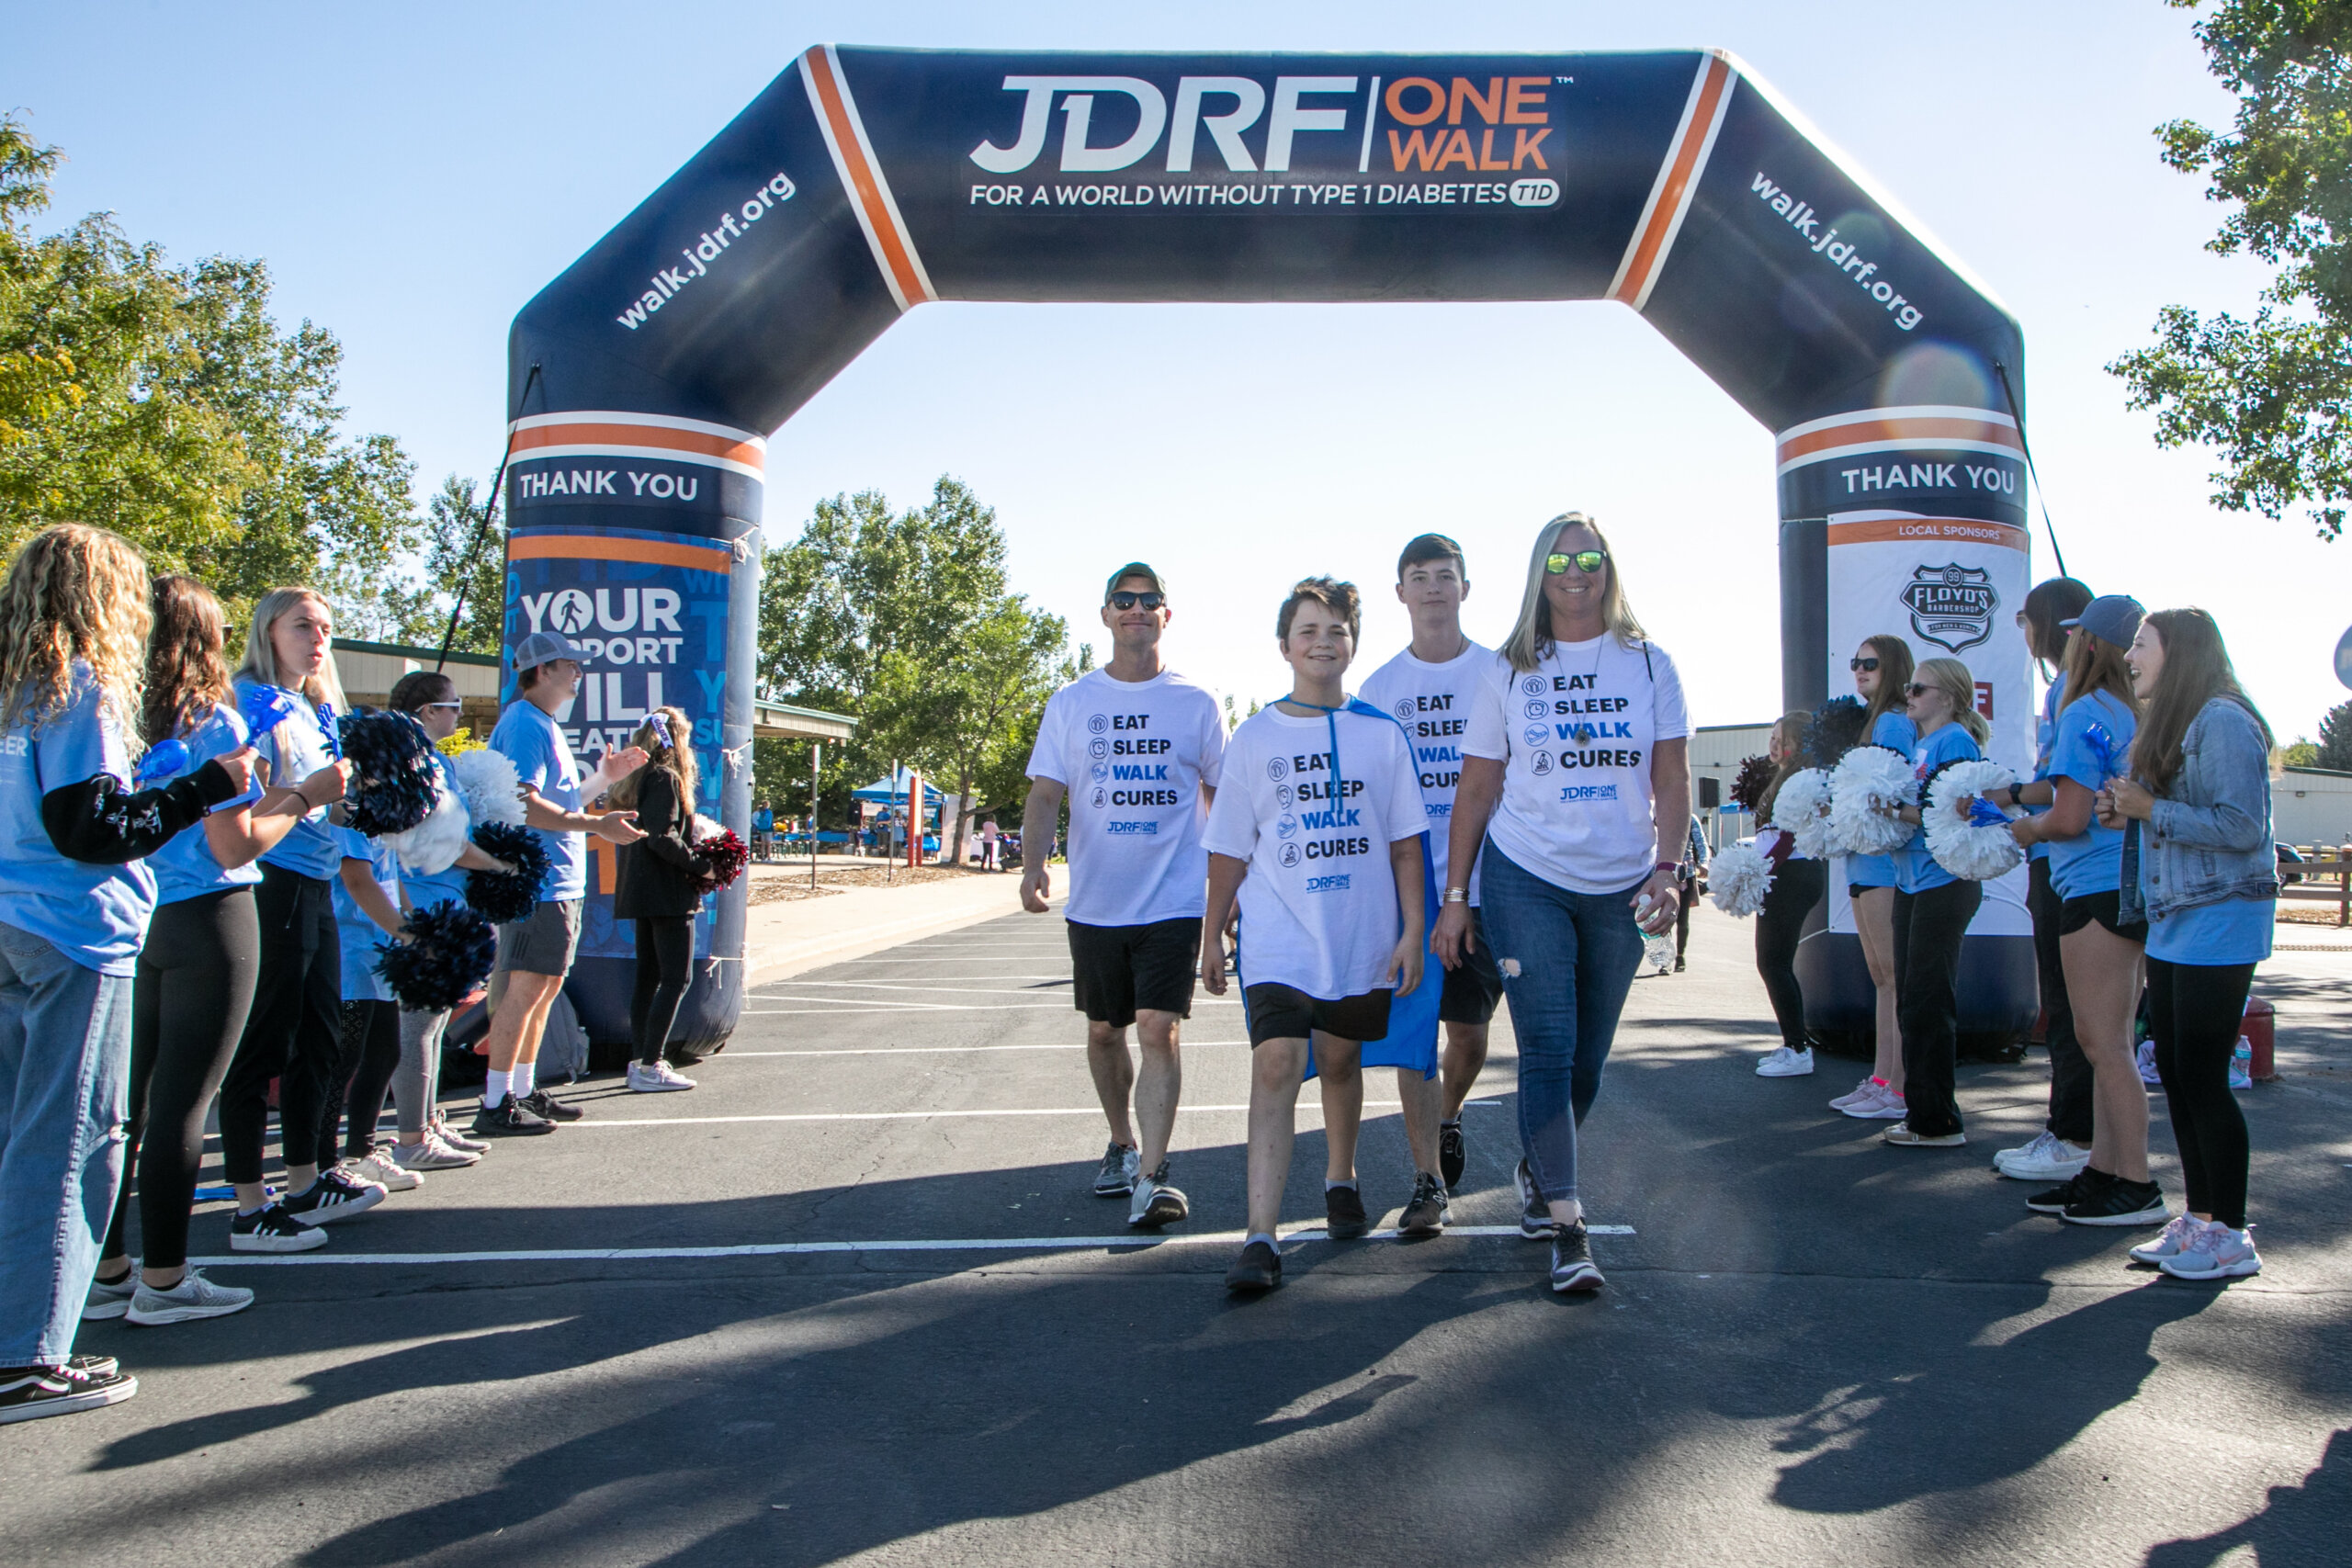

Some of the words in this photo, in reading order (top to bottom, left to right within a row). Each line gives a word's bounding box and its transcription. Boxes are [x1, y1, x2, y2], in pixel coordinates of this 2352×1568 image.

[1385, 76, 1552, 126] ONE
[969, 75, 1358, 173] JDRF
[1387, 129, 1554, 172] WALK
[970, 185, 1023, 205] FOR
[1030, 185, 1049, 205] A
[1056, 185, 1154, 205] WORLD
[1159, 185, 1285, 205] WITHOUT
[1291, 185, 1357, 204] TYPE
[1363, 185, 1371, 204] 1
[1378, 184, 1507, 204] DIABETES
[1518, 184, 1553, 201] T1D
[616, 172, 797, 330] walk.jdrf.org
[1750, 172, 1924, 331] walk.jdrf.org
[520, 470, 617, 498] THANK
[628, 471, 697, 501] YOU
[1841, 464, 1957, 493] THANK
[1964, 465, 2014, 494] YOU
[1899, 525, 1939, 536] LOCAL
[1943, 525, 2000, 540] SPONSORS
[1948, 571, 1960, 581] 99
[1915, 588, 1988, 610] FLOYD'S
[522, 588, 683, 634] YOUR
[1928, 604, 1979, 613] BARBERSHOP
[1553, 673, 1597, 691] EAT
[1417, 694, 1454, 711] EAT
[1555, 698, 1629, 715] SLEEP
[1113, 715, 1149, 730] EAT
[1555, 722, 1633, 740] WALK
[1113, 739, 1171, 755] SLEEP
[1418, 746, 1464, 762] WAL
[1560, 750, 1642, 769] CURES
[1113, 765, 1169, 780] WALK
[1112, 790, 1178, 806] CURES
[1297, 780, 1364, 802] SLEEP
[1560, 786, 1598, 800] JDRF
[1107, 821, 1141, 831] JDRF
[1301, 809, 1361, 830] WALK
[1306, 837, 1369, 859] CURES
